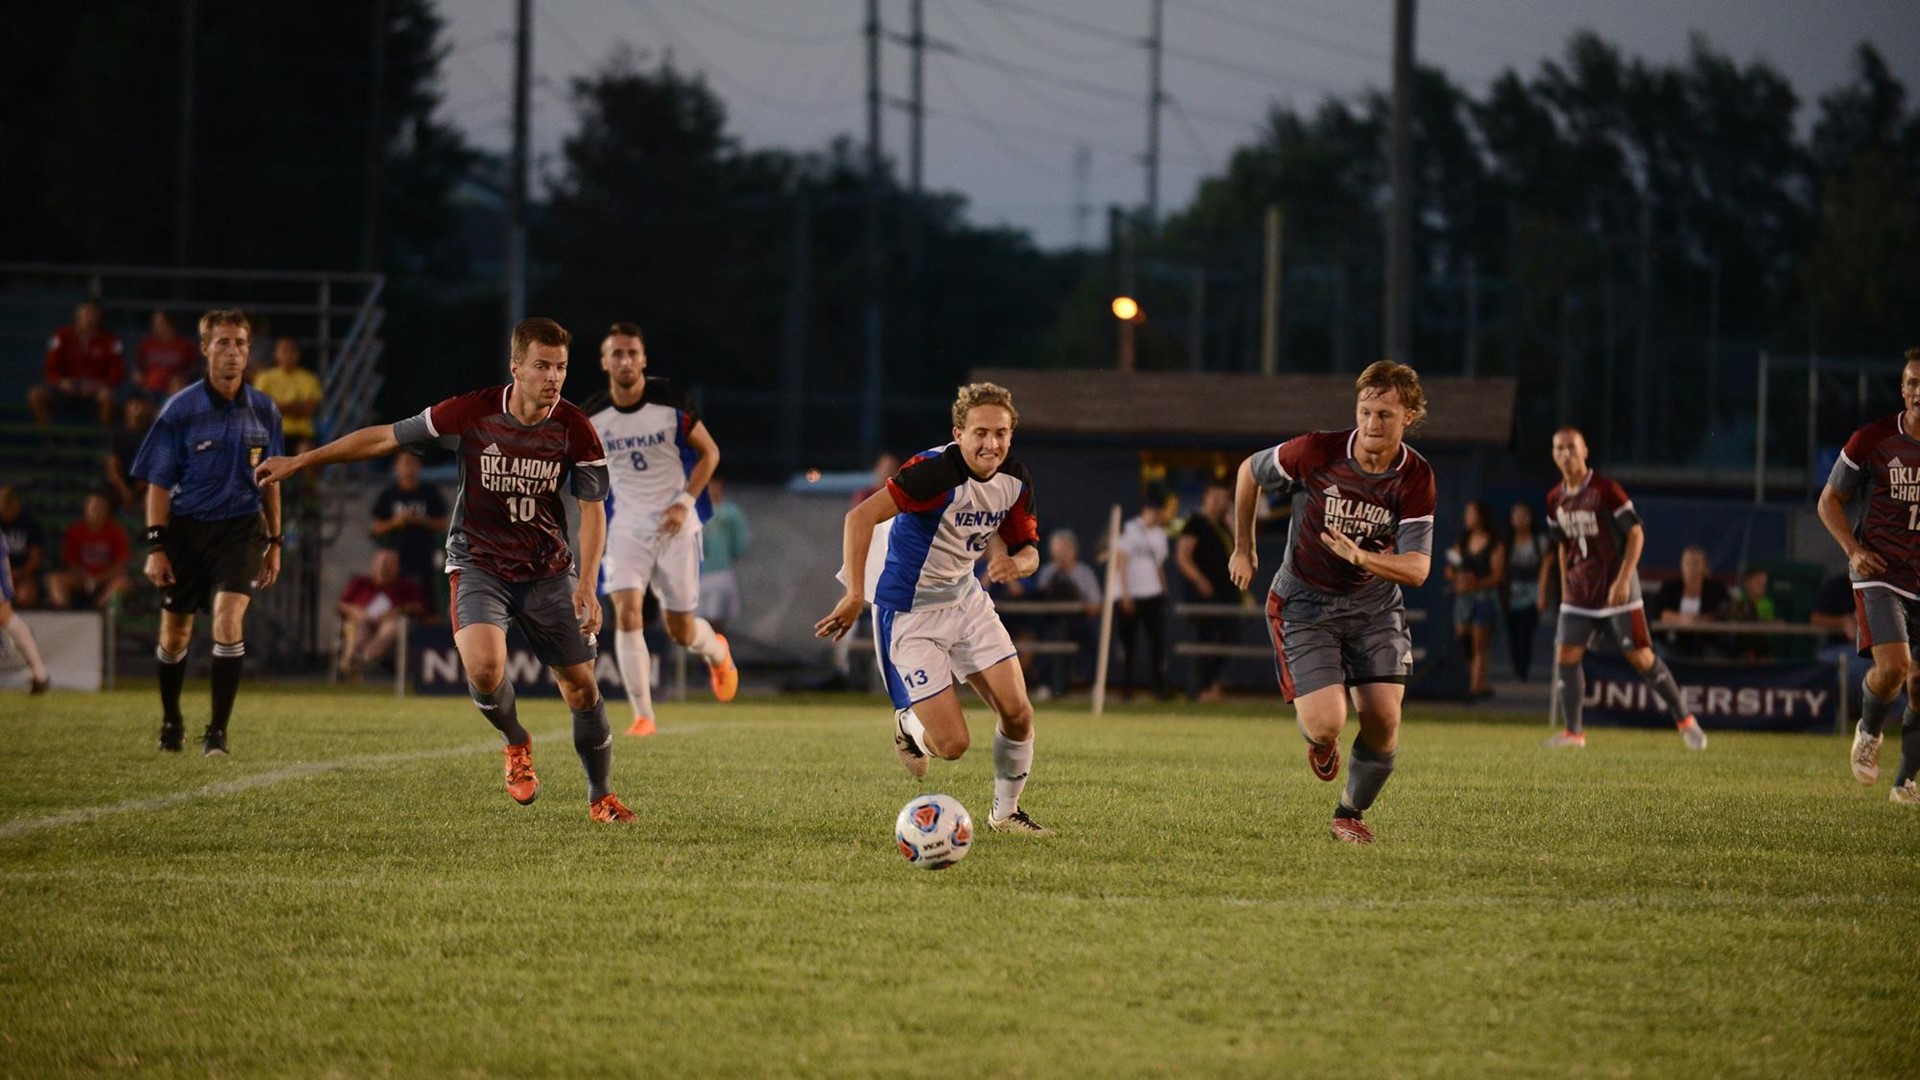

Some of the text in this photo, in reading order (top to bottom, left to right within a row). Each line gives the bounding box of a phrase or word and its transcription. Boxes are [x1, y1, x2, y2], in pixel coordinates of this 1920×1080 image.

[606, 431, 665, 451] NEWMAN
[480, 455, 560, 479] OKLAHOMA
[631, 451, 648, 471] 8
[481, 473, 558, 495] CHRISTIAN
[507, 497, 536, 523] 10
[1325, 497, 1393, 525] OKLAHOM
[904, 669, 928, 688] 13
